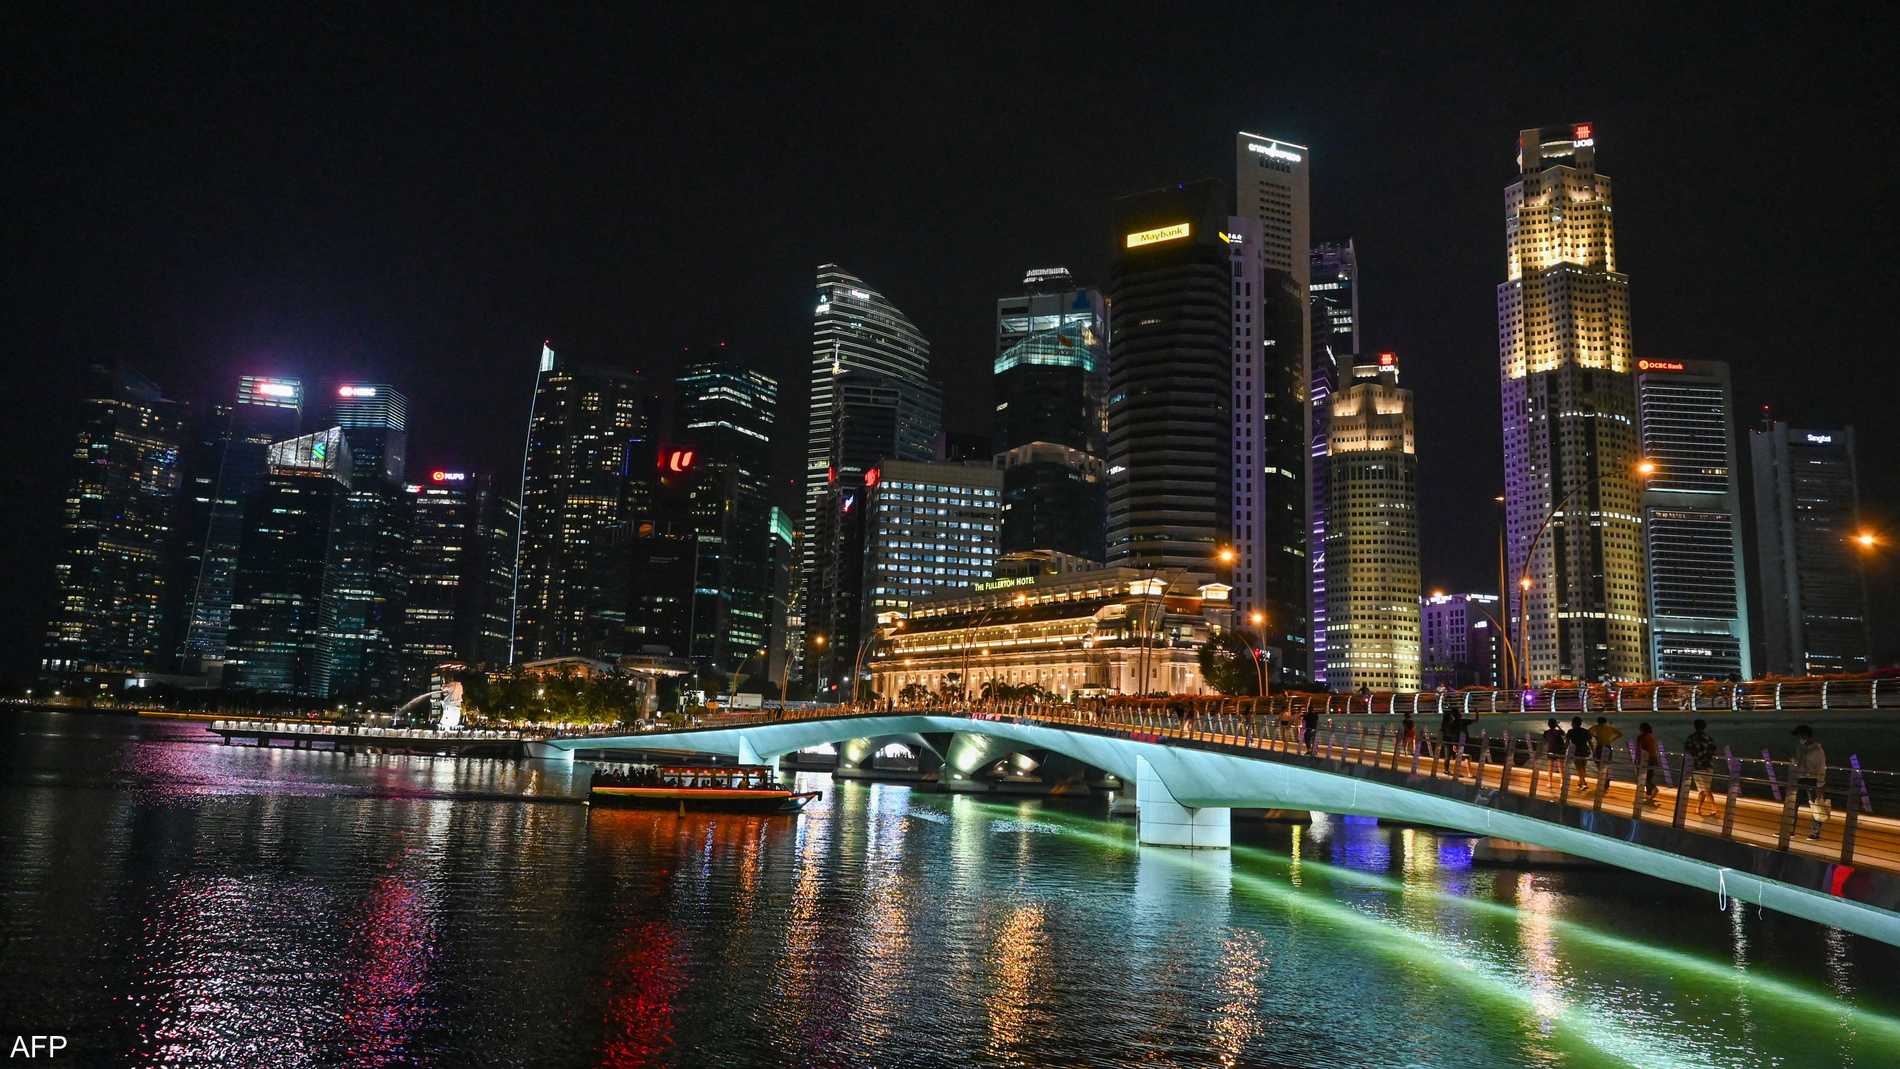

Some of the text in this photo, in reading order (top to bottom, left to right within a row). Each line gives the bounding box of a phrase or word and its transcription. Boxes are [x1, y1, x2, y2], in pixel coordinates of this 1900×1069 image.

[1140, 227, 1183, 242] Maybank
[975, 576, 1035, 591] THE FULLERTON HOTEL
